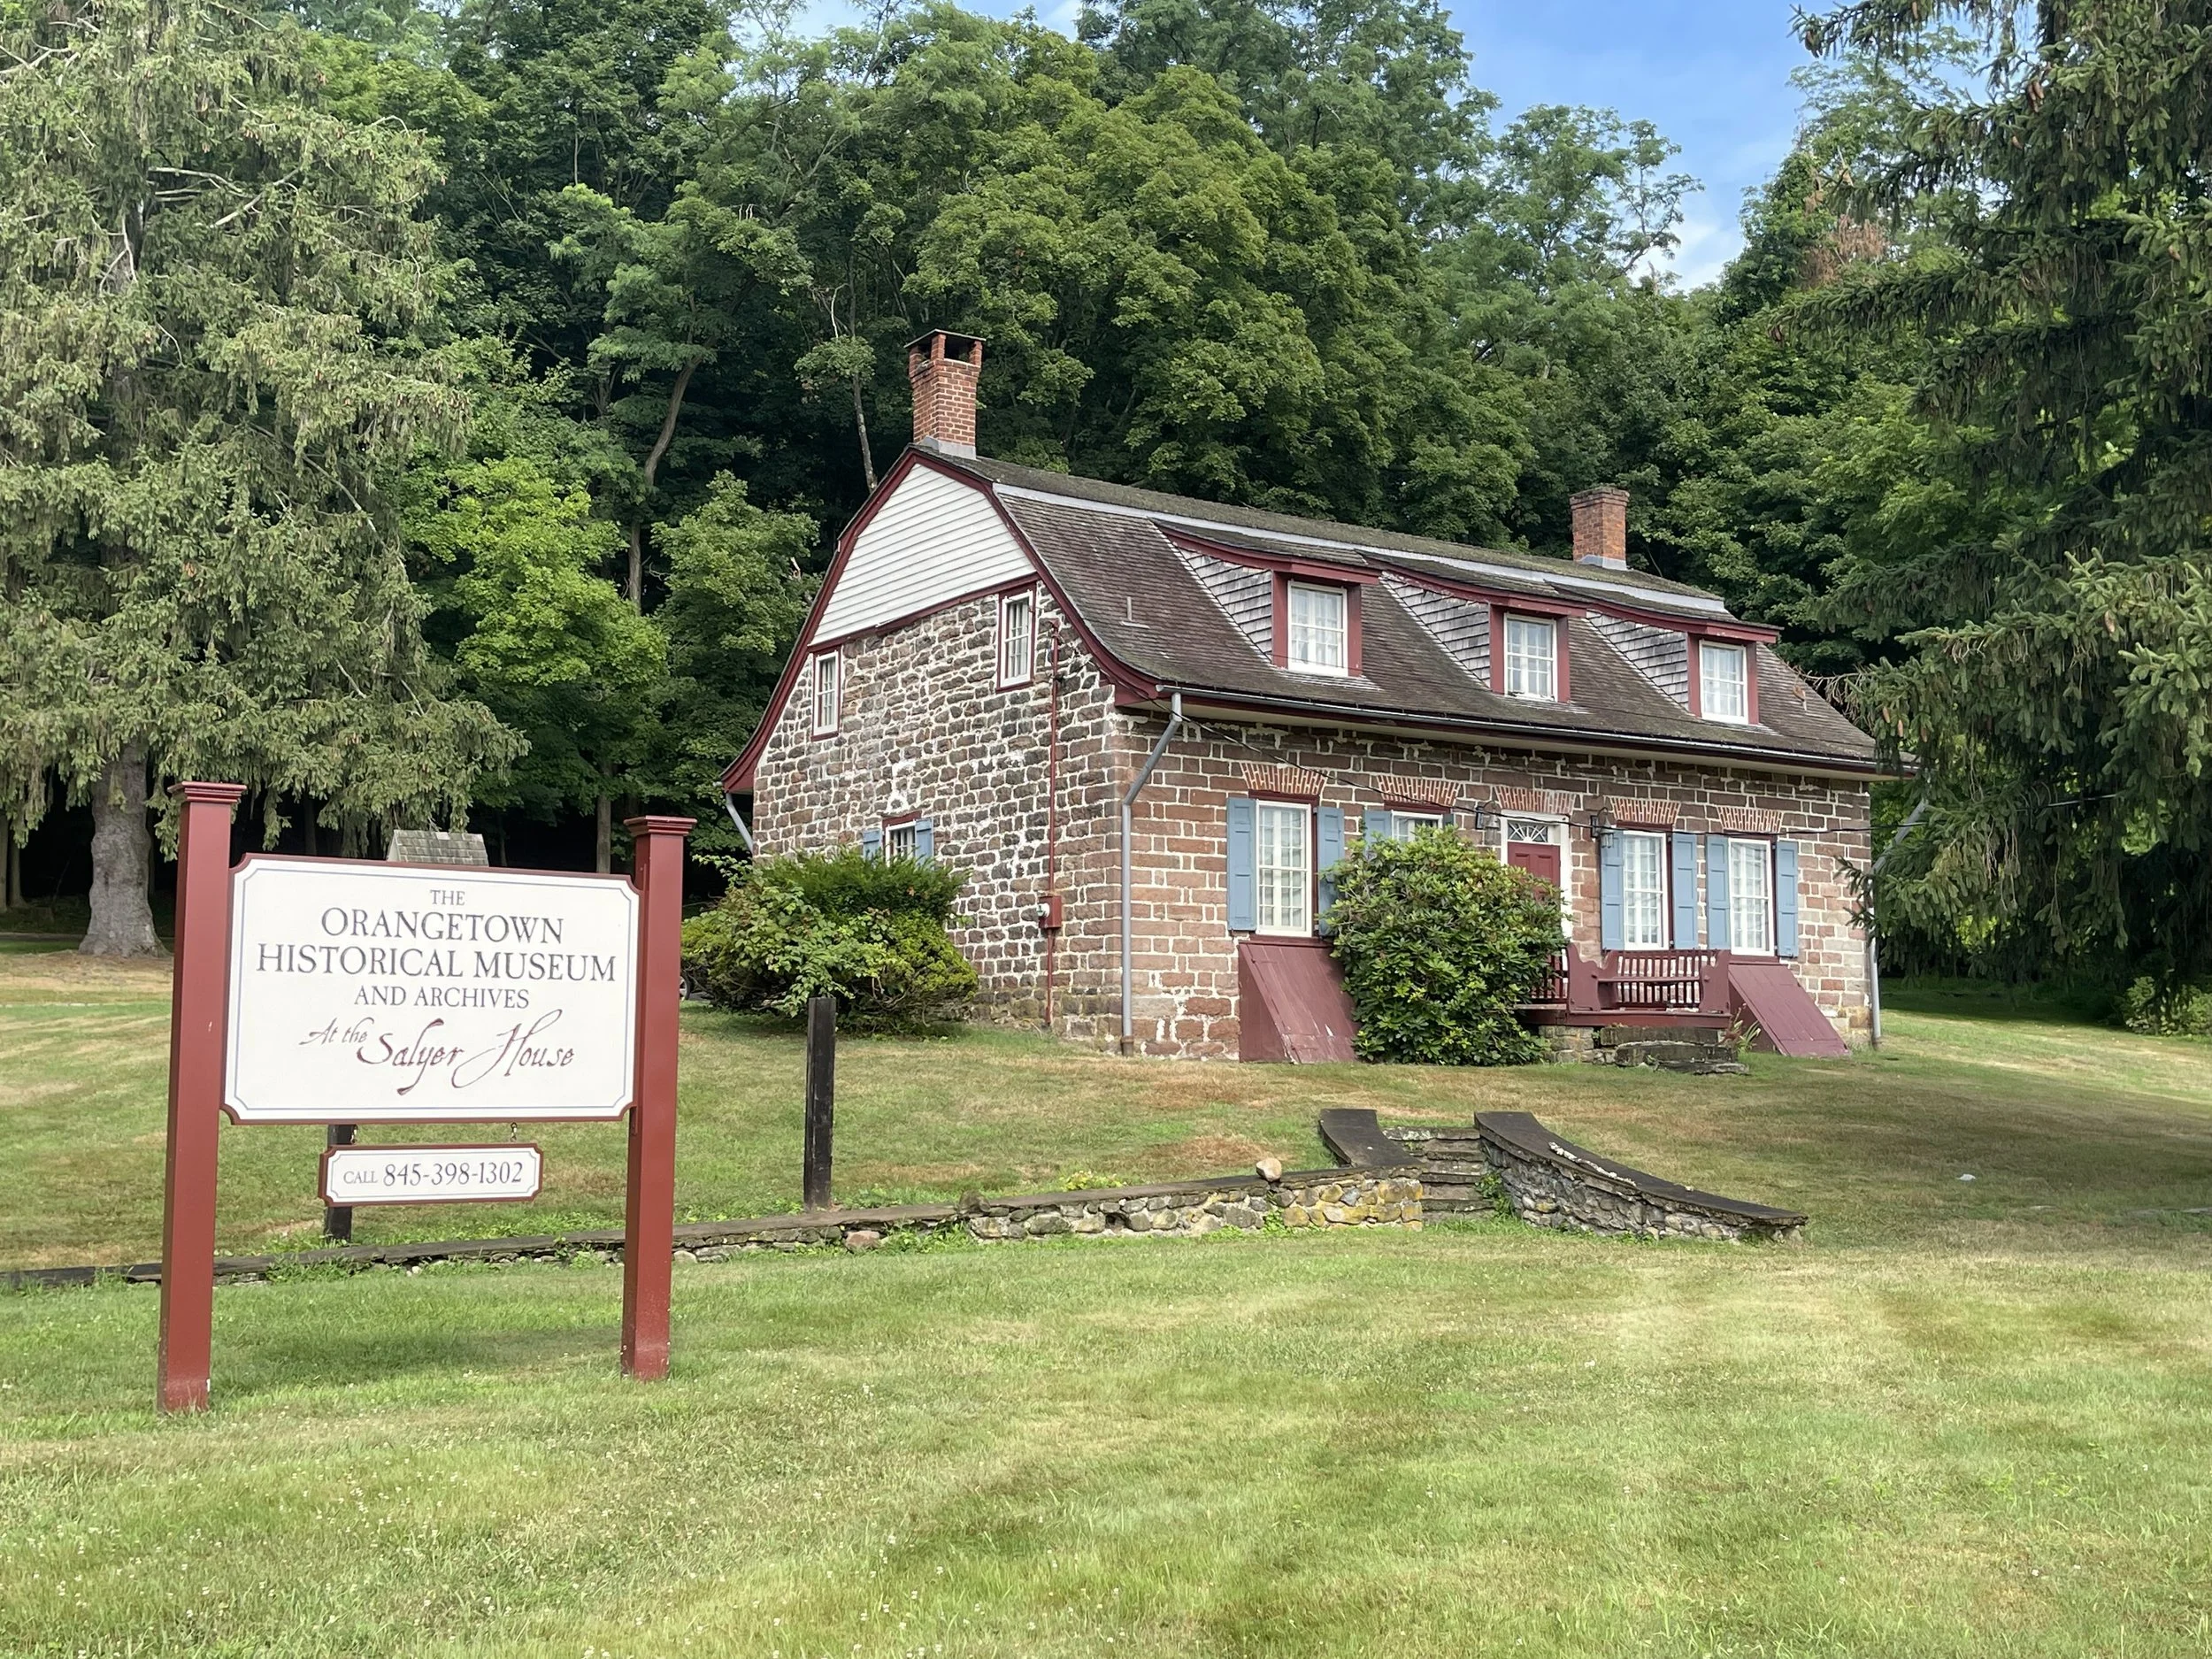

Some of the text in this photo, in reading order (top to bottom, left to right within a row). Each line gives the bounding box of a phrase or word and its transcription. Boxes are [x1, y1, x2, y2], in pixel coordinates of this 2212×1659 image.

[431, 889, 465, 906] THE
[321, 907, 565, 944] ORANGETOWN
[256, 943, 616, 981] HISTORICAL MUSEUM
[354, 986, 529, 1009] AND ARCHIVES
[299, 1010, 574, 1095] At the Salyer House
[343, 1161, 523, 1187] CALL 845-398-1302
